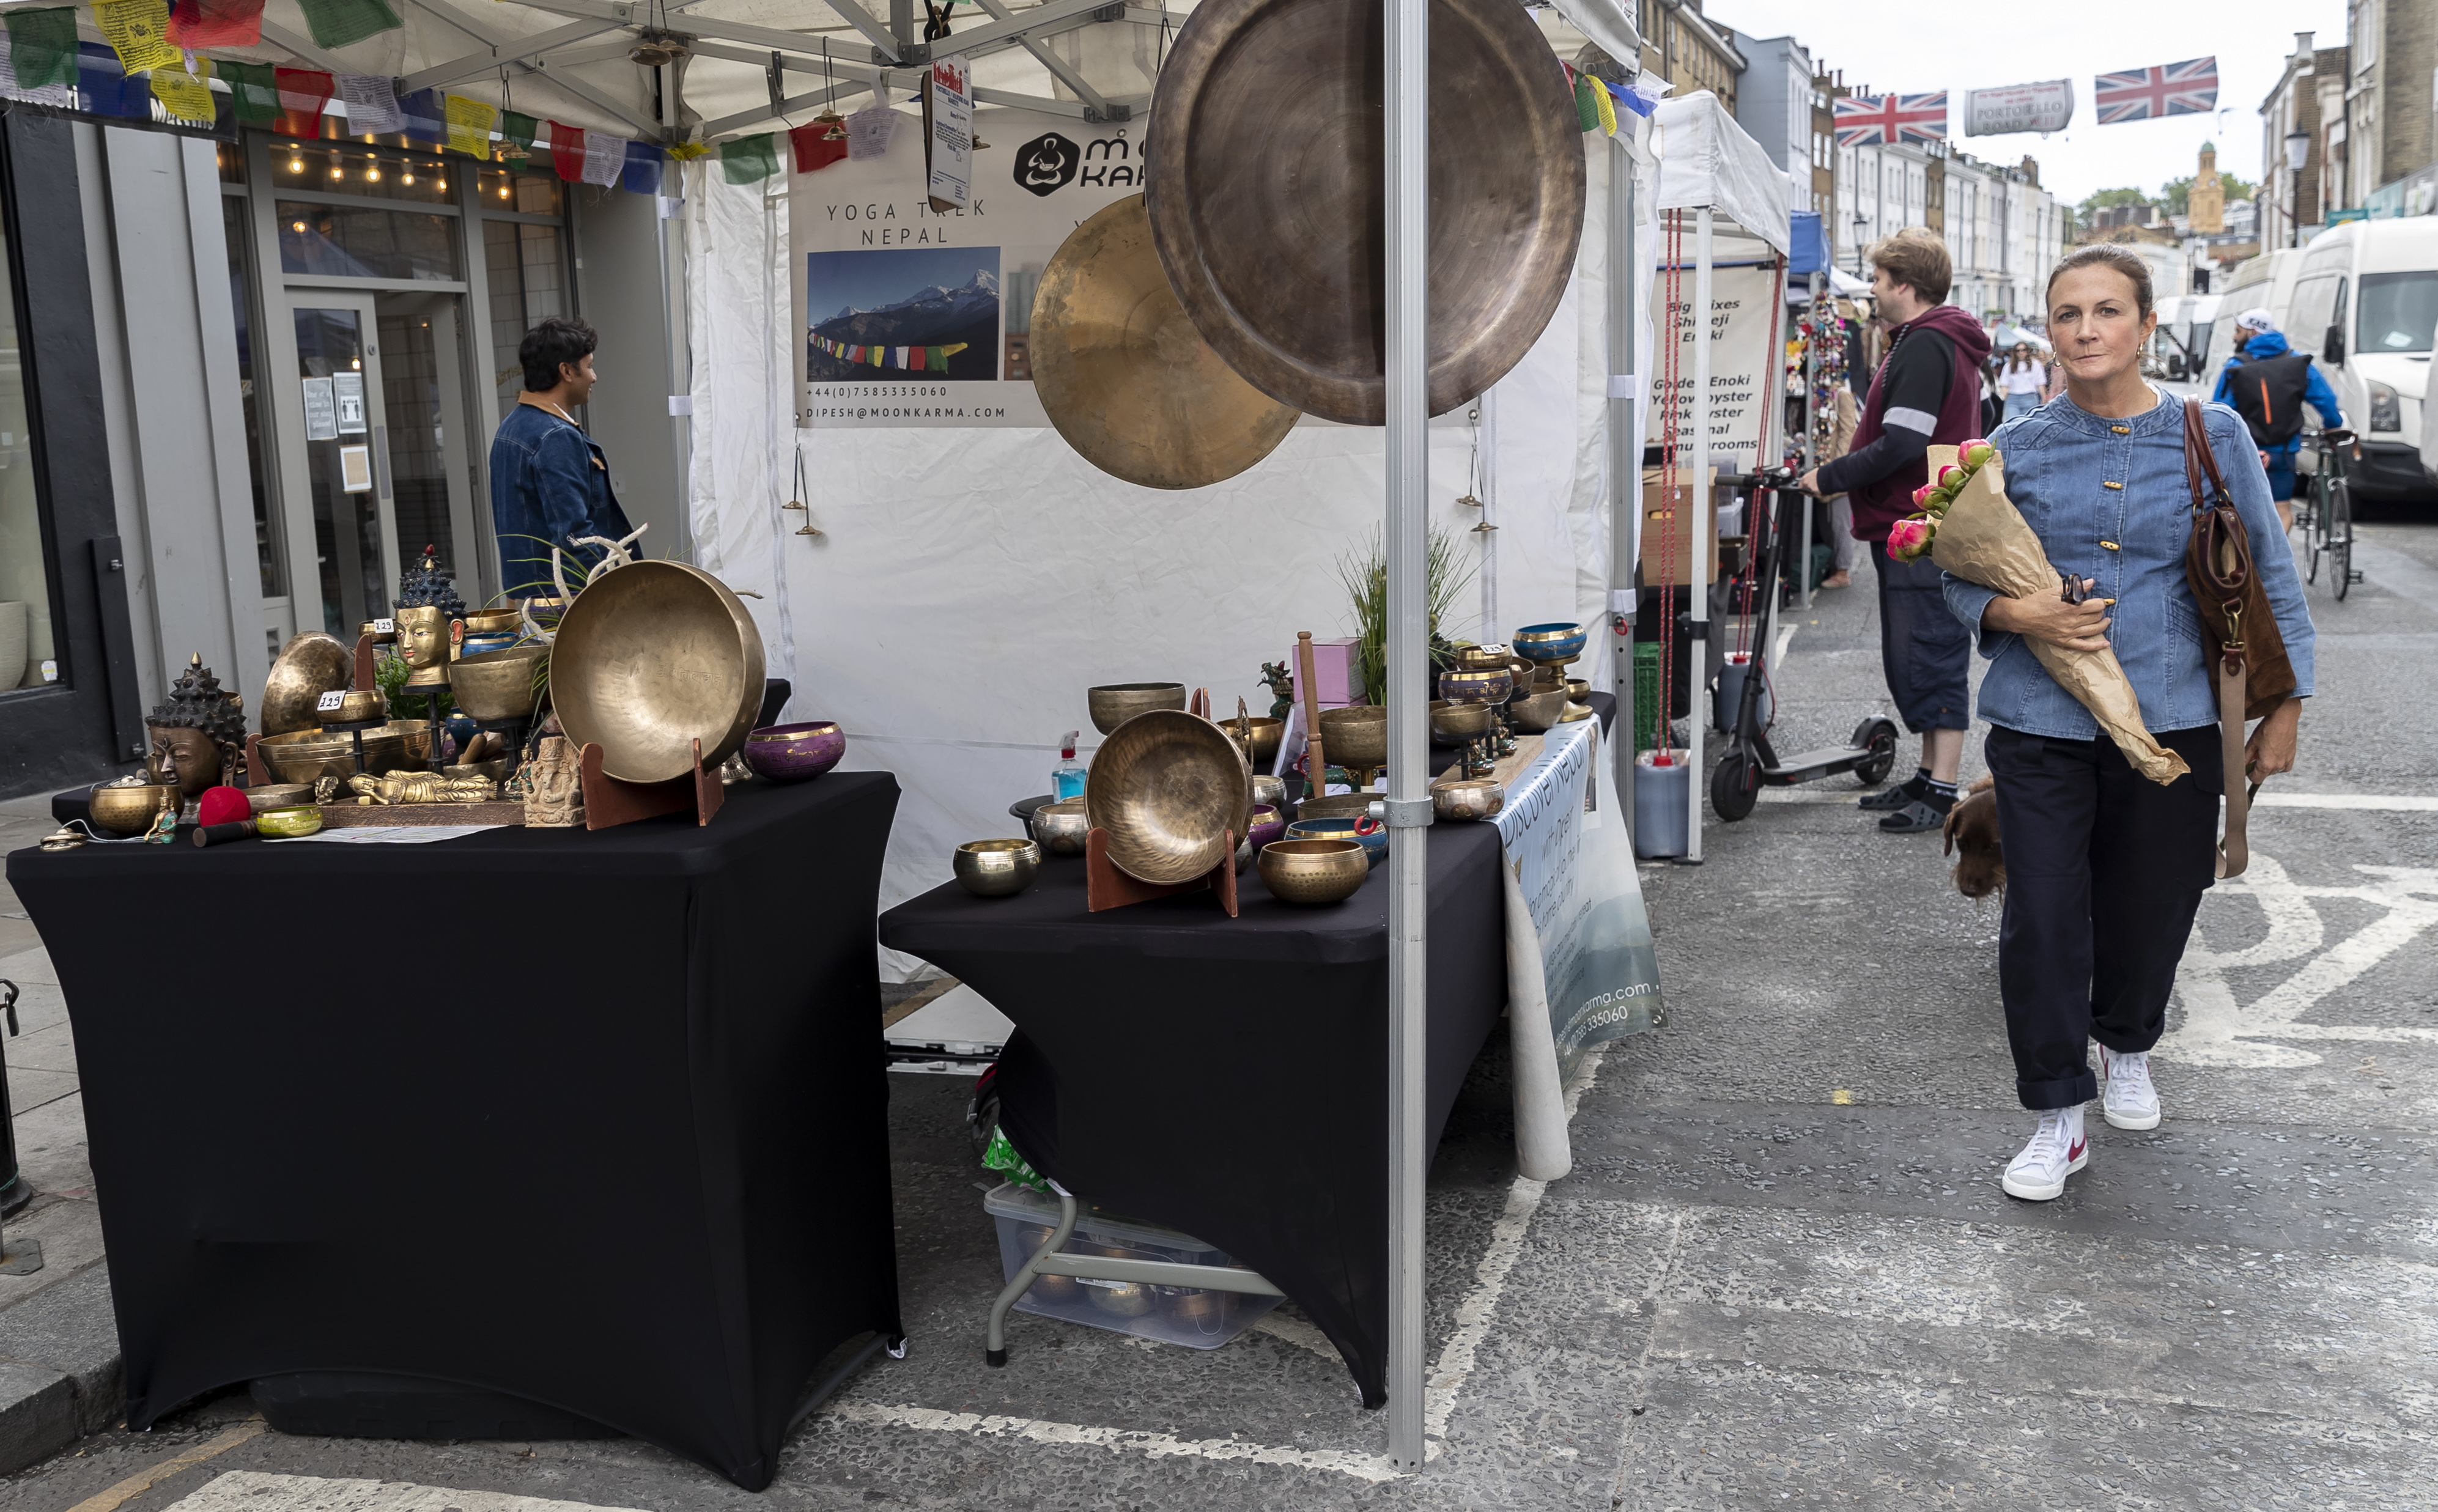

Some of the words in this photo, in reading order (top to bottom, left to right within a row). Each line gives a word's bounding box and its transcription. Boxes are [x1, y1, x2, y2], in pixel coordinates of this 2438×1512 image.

[827, 203, 896, 221] YOGA
[862, 227, 947, 245] NEPAL
[1672, 314, 1731, 328] Shieji
[1682, 330, 1724, 342] Eki
[1710, 374, 1751, 387] Enoki
[807, 386, 947, 399] +44(0)7585335060
[807, 407, 1005, 419] DIPESH@MOONKARMA.COM
[1587, 1005, 1628, 1032] 335060
